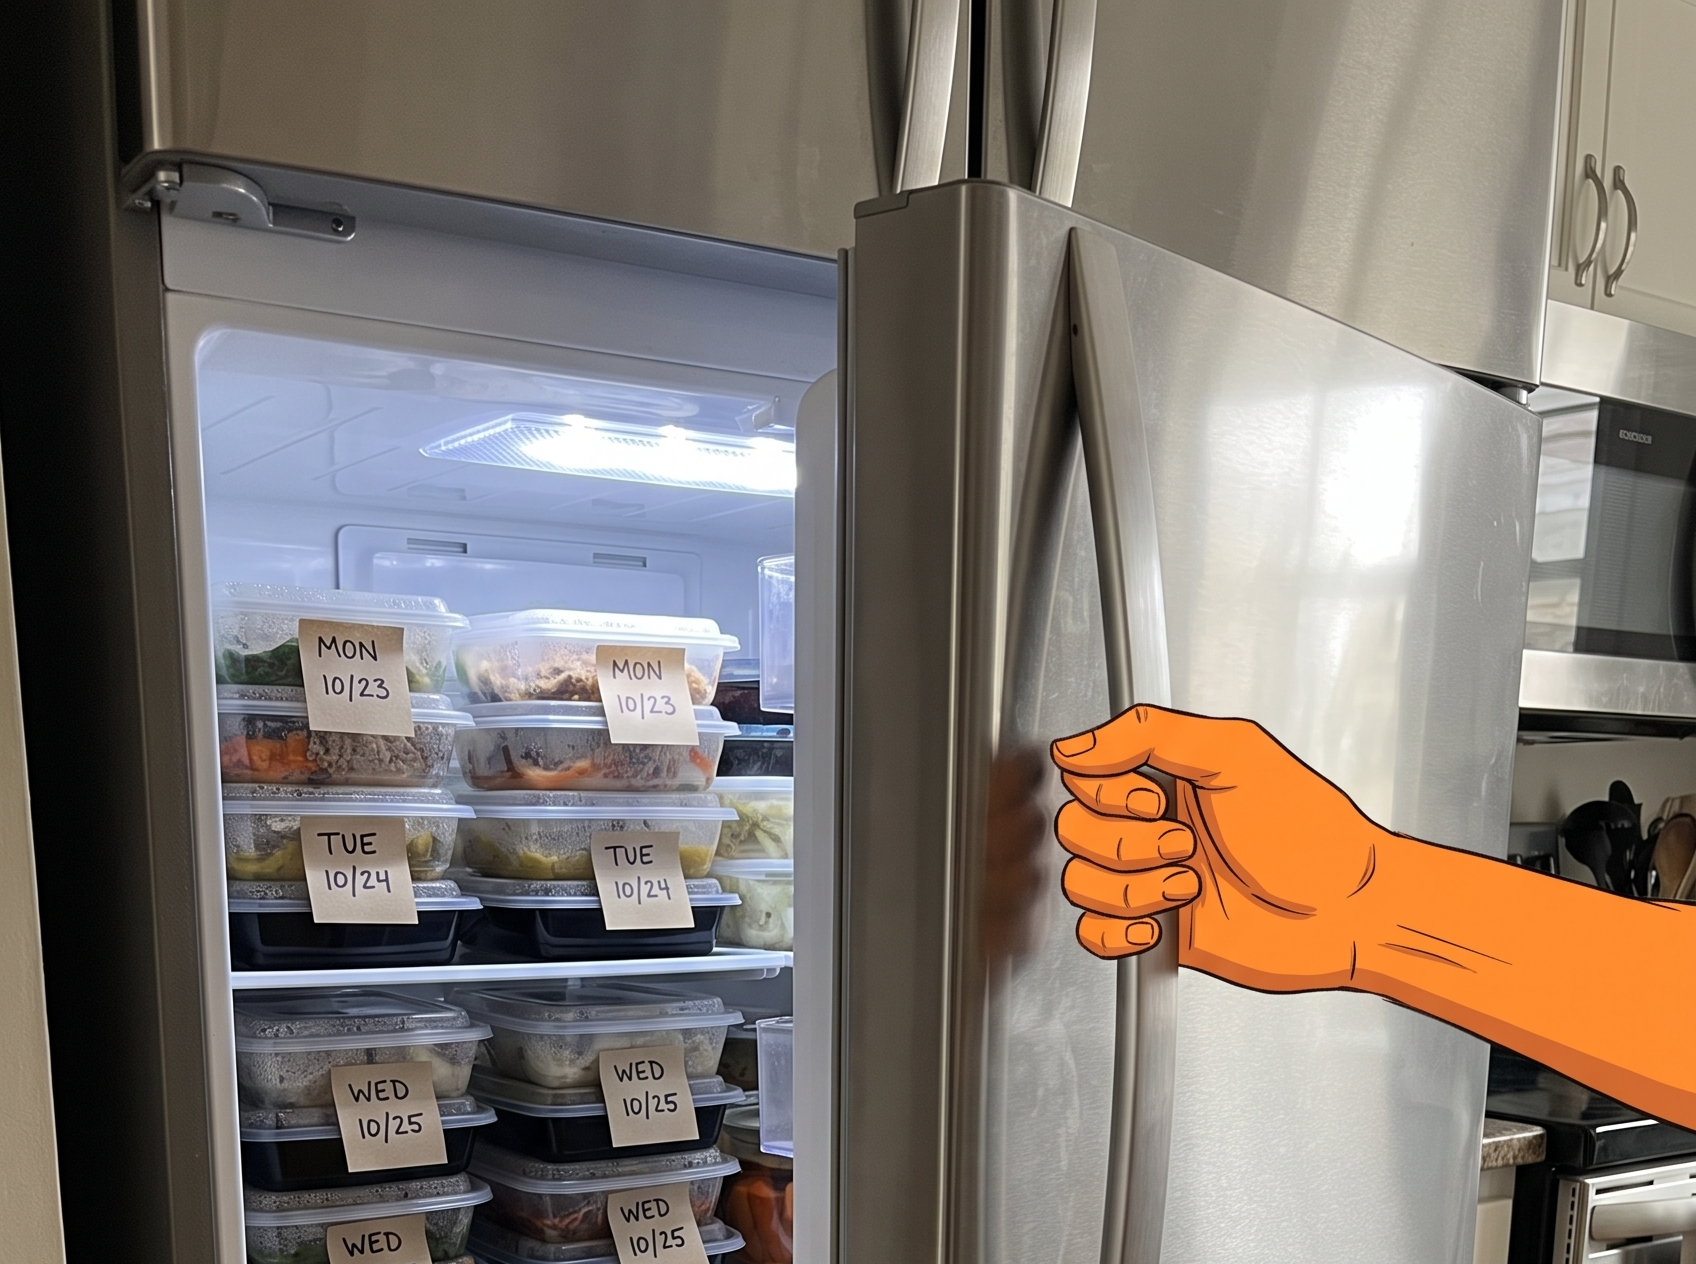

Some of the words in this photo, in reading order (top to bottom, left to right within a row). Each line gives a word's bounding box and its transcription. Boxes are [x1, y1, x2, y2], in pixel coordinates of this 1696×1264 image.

[318, 636, 377, 661] MON
[613, 659, 661, 680] MON
[323, 673, 389, 702] 10/23
[618, 692, 676, 719] 10/23
[317, 832, 376, 855] TUE
[604, 845, 653, 866] TUE
[325, 866, 391, 897] 10/24
[615, 875, 671, 905] 10/24
[614, 1060, 664, 1082] WED
[348, 1079, 409, 1102] WED
[623, 1091, 677, 1120] 10/25
[359, 1112, 423, 1143] 10/25
[620, 1198, 669, 1223] WED
[342, 1232, 402, 1257] WED
[629, 1227, 685, 1258] 10/25
